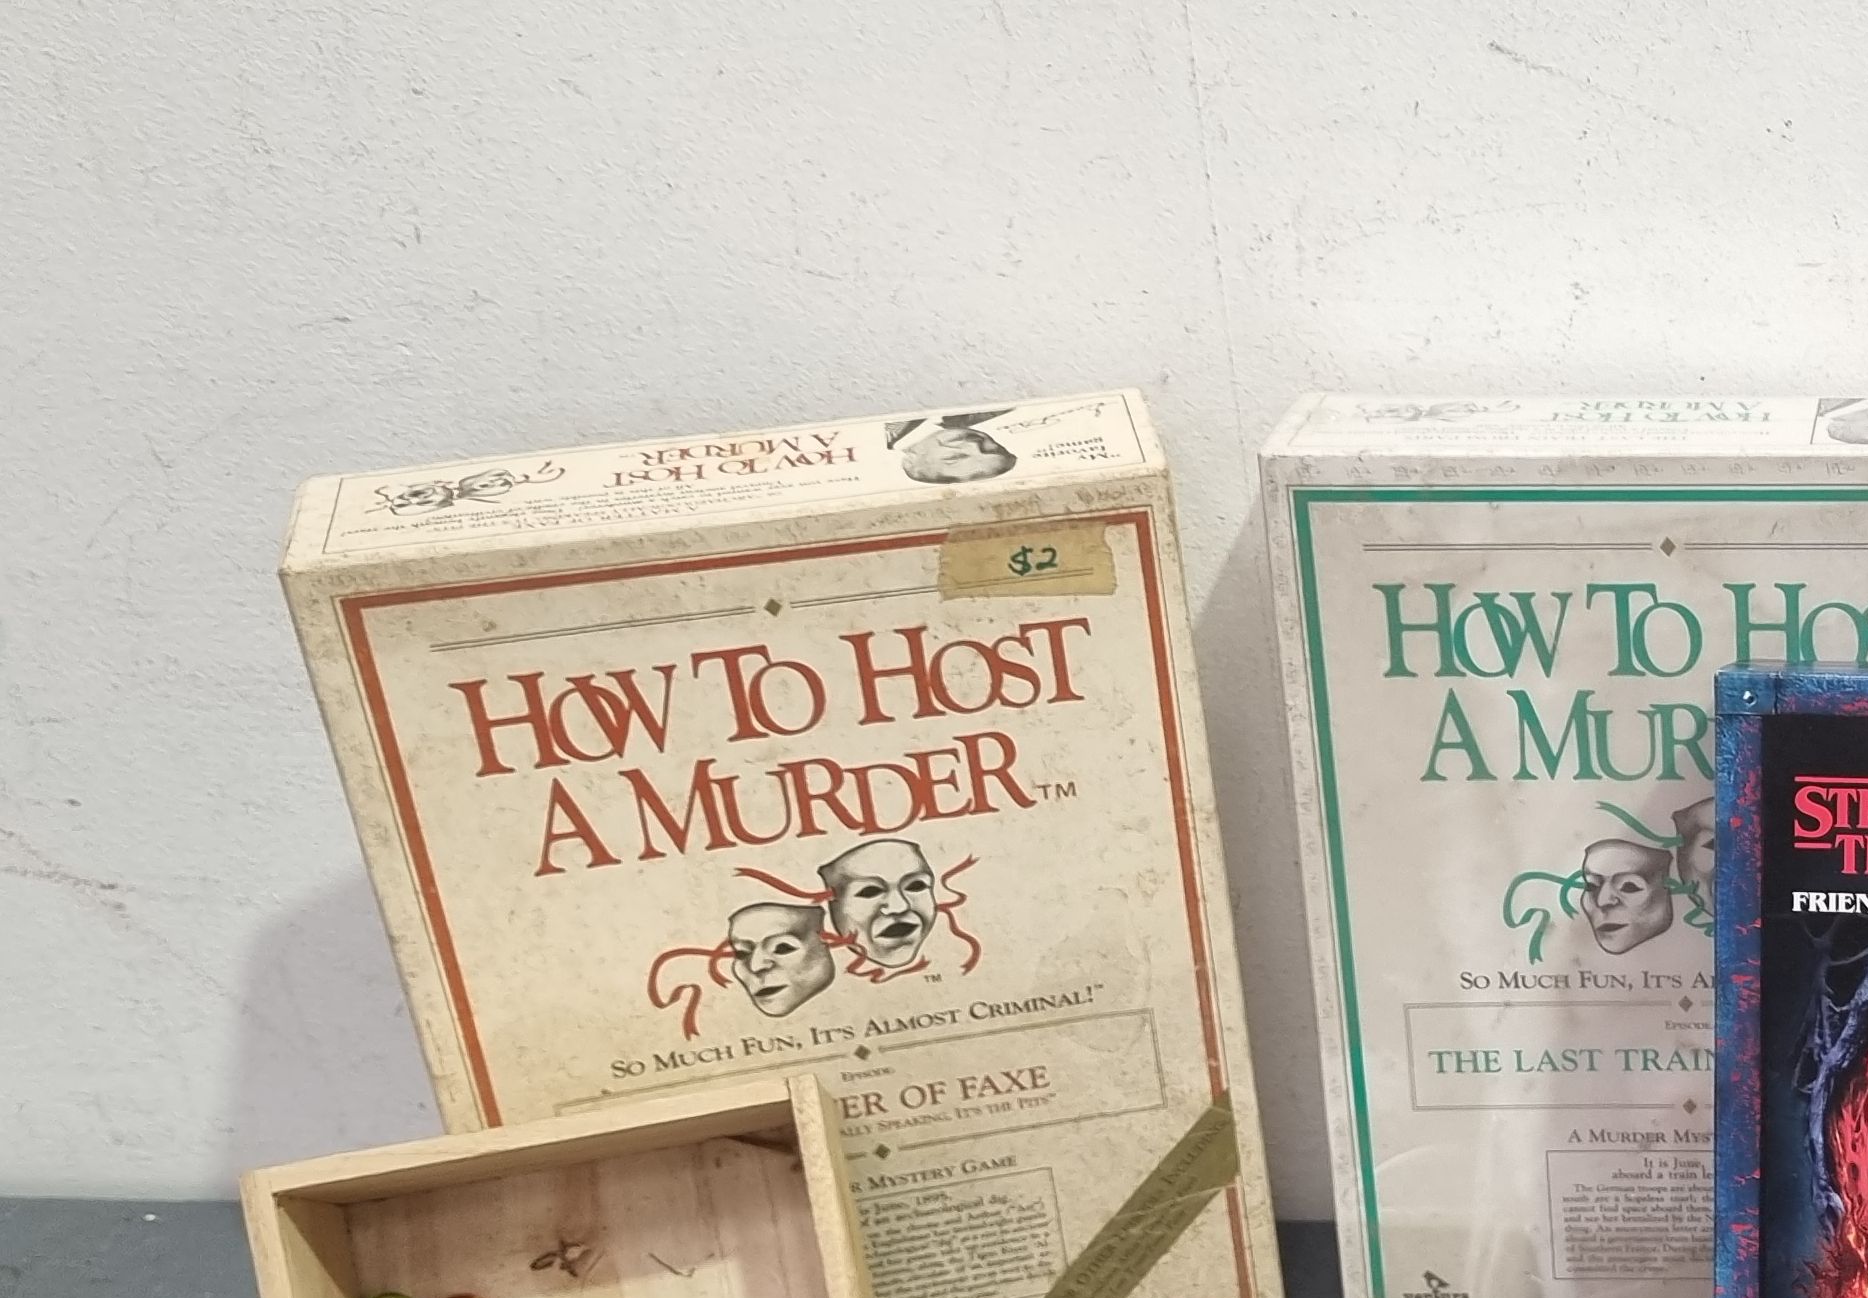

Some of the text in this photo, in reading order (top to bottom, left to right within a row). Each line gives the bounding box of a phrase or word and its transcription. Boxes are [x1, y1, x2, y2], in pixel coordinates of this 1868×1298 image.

[1007, 545, 1059, 577] $2
[1373, 583, 1574, 679] HOW
[1586, 583, 1705, 679] TO
[447, 617, 1092, 777] HOW TO HOST
[1420, 688, 1498, 783] A
[534, 777, 622, 877] A
[617, 731, 1038, 861] MURDER
[1460, 970, 1683, 992] SO MUCH FUN, IT'S
[610, 1058, 645, 1079] SO
[652, 1044, 734, 1073] MUCH
[739, 1035, 803, 1057] FUN,
[864, 1007, 962, 1039] ALMOST
[1428, 1048, 1503, 1074] THE
[1515, 1048, 1604, 1073] LAST
[835, 1065, 1052, 1120] ER OF FAXE
[1568, 1128, 1667, 1144] A MURDER
[867, 1155, 1019, 1191] MYSTERY GAME
[1612, 1168, 1653, 1180] aboard
[1668, 1169, 1698, 1180] train
